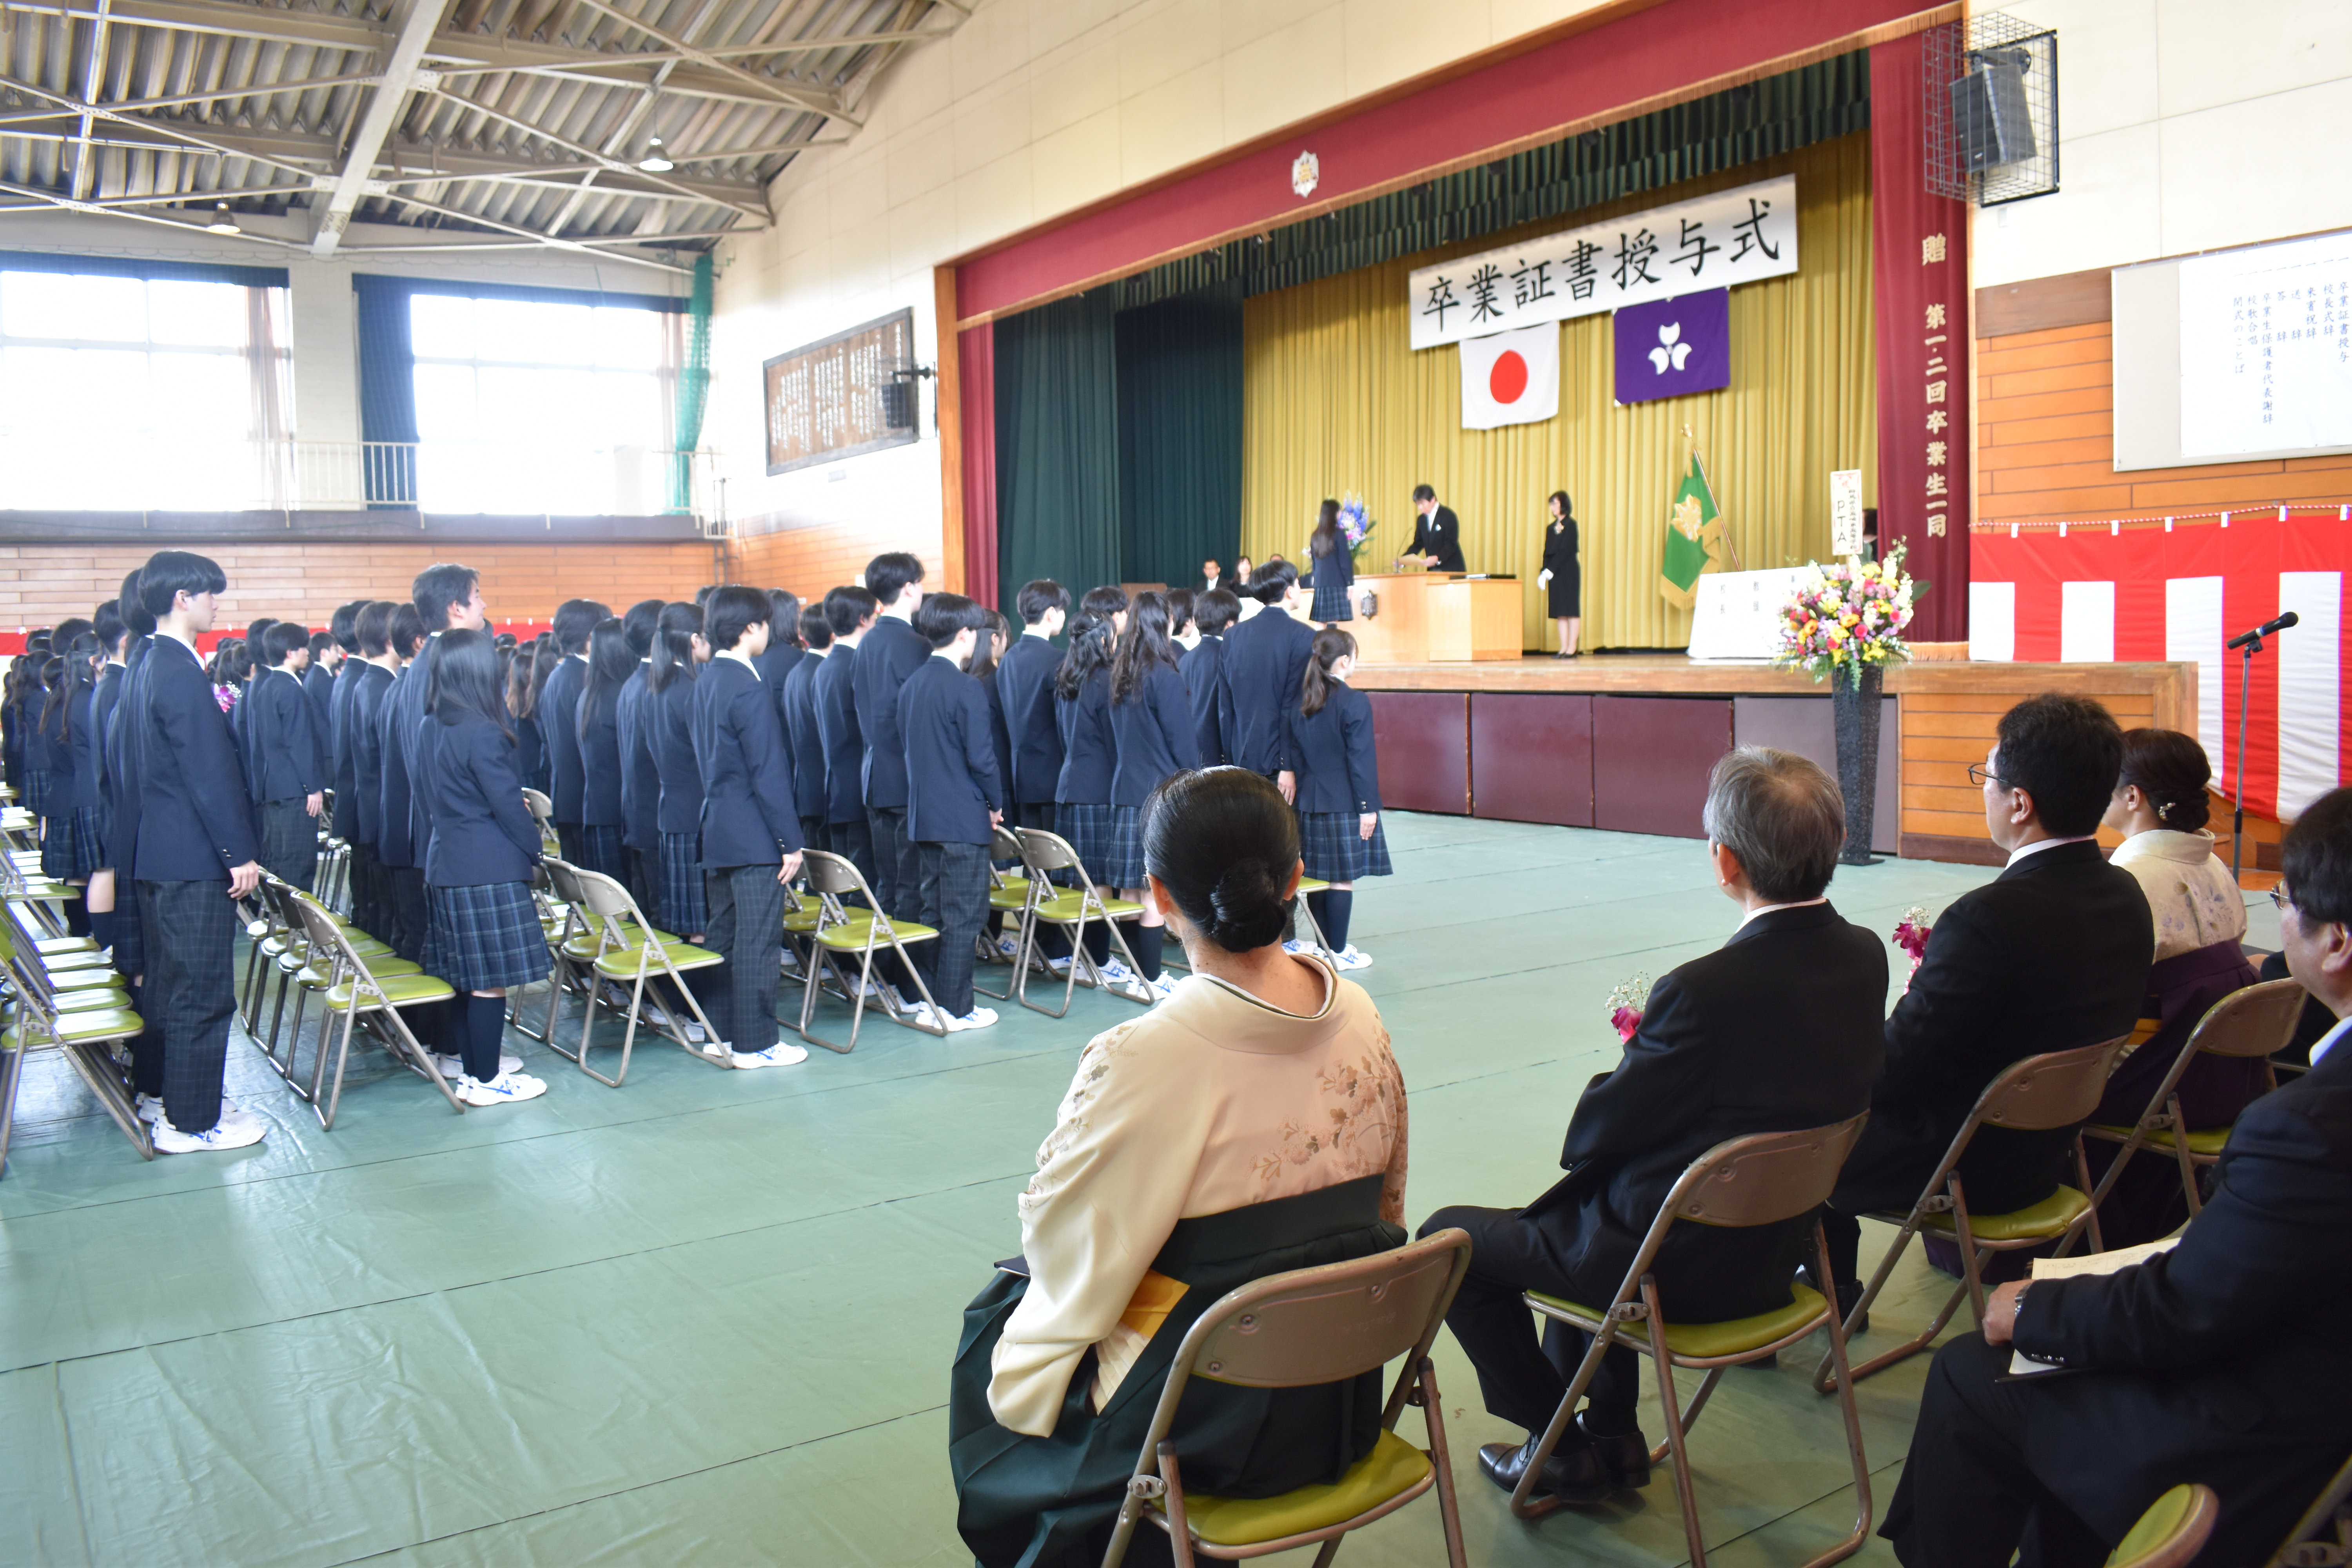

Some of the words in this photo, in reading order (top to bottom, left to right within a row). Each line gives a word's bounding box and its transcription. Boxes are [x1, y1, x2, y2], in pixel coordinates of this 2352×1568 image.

[1422, 198, 1780, 332] 卒業証書授与式
[1922, 232, 1947, 266] 贈
[2247, 295, 2258, 345] 校歌合唱
[2305, 287, 2317, 339] 来賓祝辞
[2323, 283, 2335, 336] 校長式辞
[2337, 281, 2350, 363] 卒業証書授与
[1837, 500, 1847, 543] PTA
